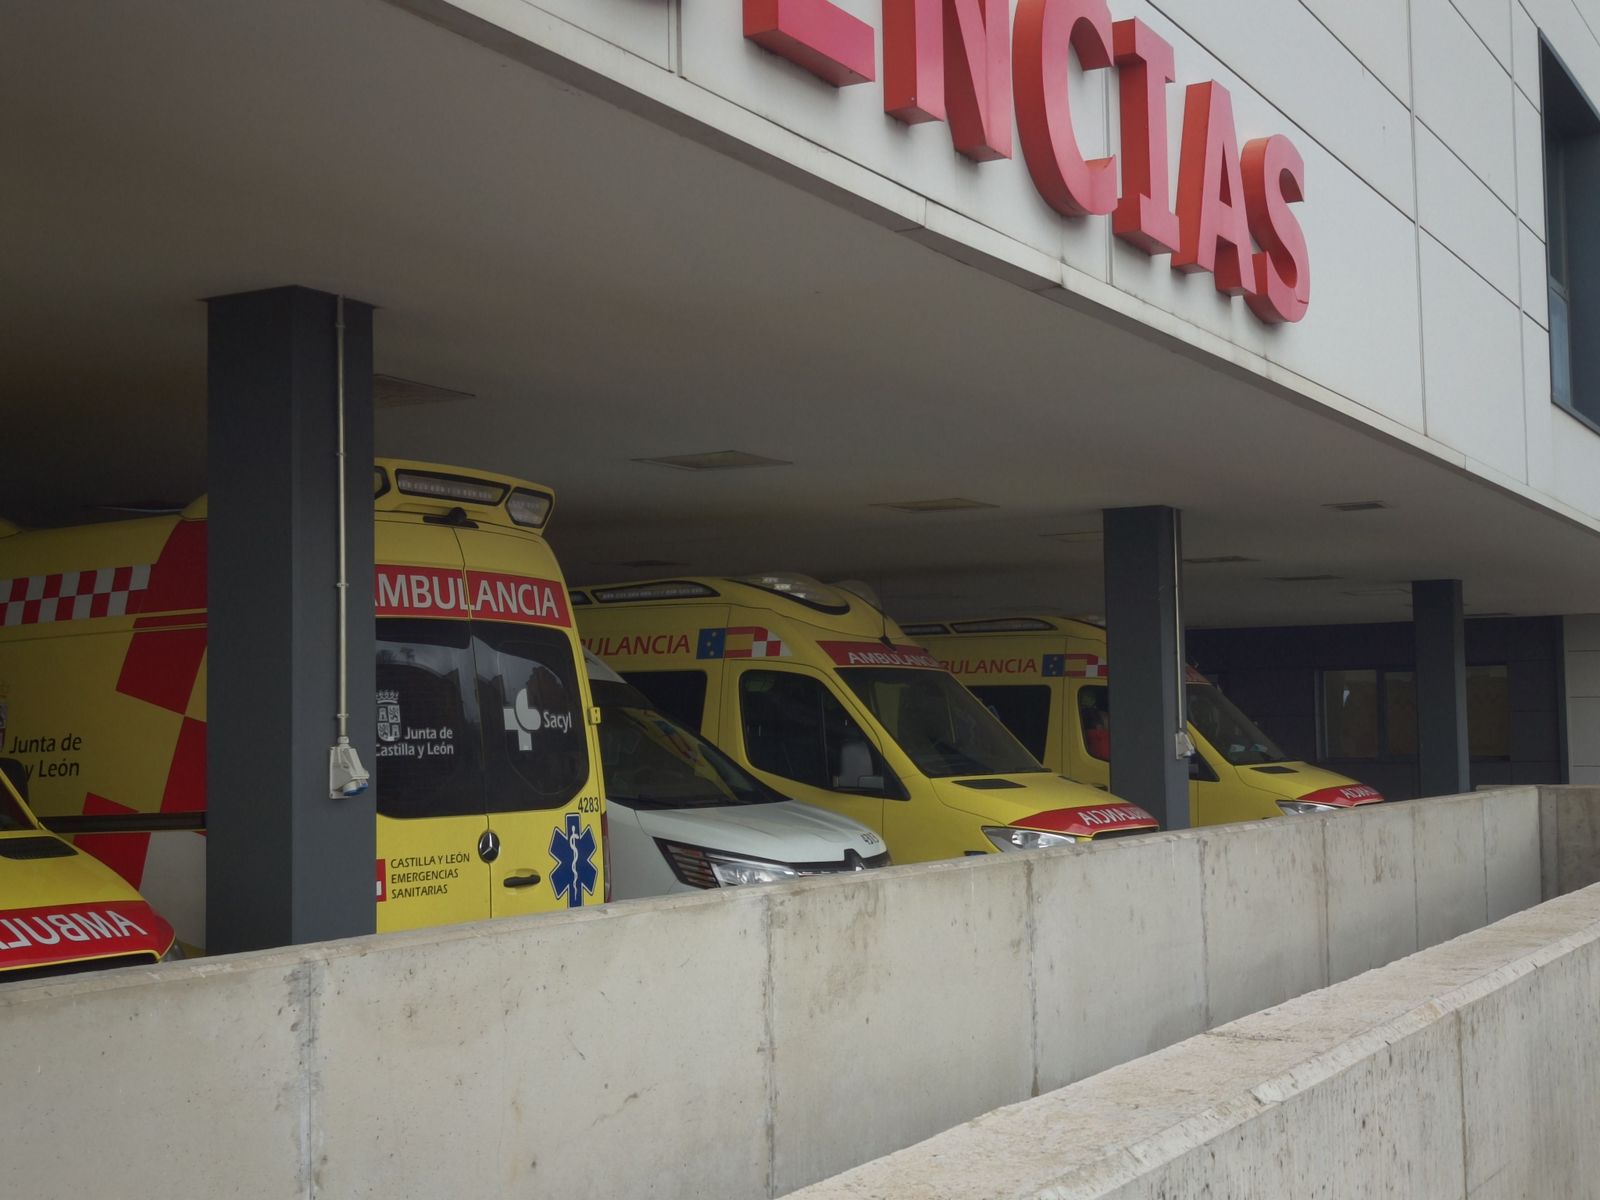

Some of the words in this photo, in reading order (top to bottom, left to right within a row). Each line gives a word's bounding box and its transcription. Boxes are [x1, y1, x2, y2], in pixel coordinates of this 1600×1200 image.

[742, 0, 1310, 323] NCIAS
[375, 573, 560, 619] MBULANCIA
[543, 711, 572, 734] Sacyl
[404, 726, 437, 740] Junta
[439, 726, 453, 739] de
[9, 735, 56, 754] Junta
[61, 732, 82, 752] de
[417, 744, 425, 759] y
[427, 741, 454, 755] León
[39, 758, 80, 778] León
[577, 797, 600, 813] 4283
[390, 855, 436, 869] CASTILLA
[437, 854, 444, 865] Y
[445, 851, 470, 864] LEÓN
[391, 868, 459, 884] EMERGENCIAS
[391, 884, 448, 899] SANITARIAS
